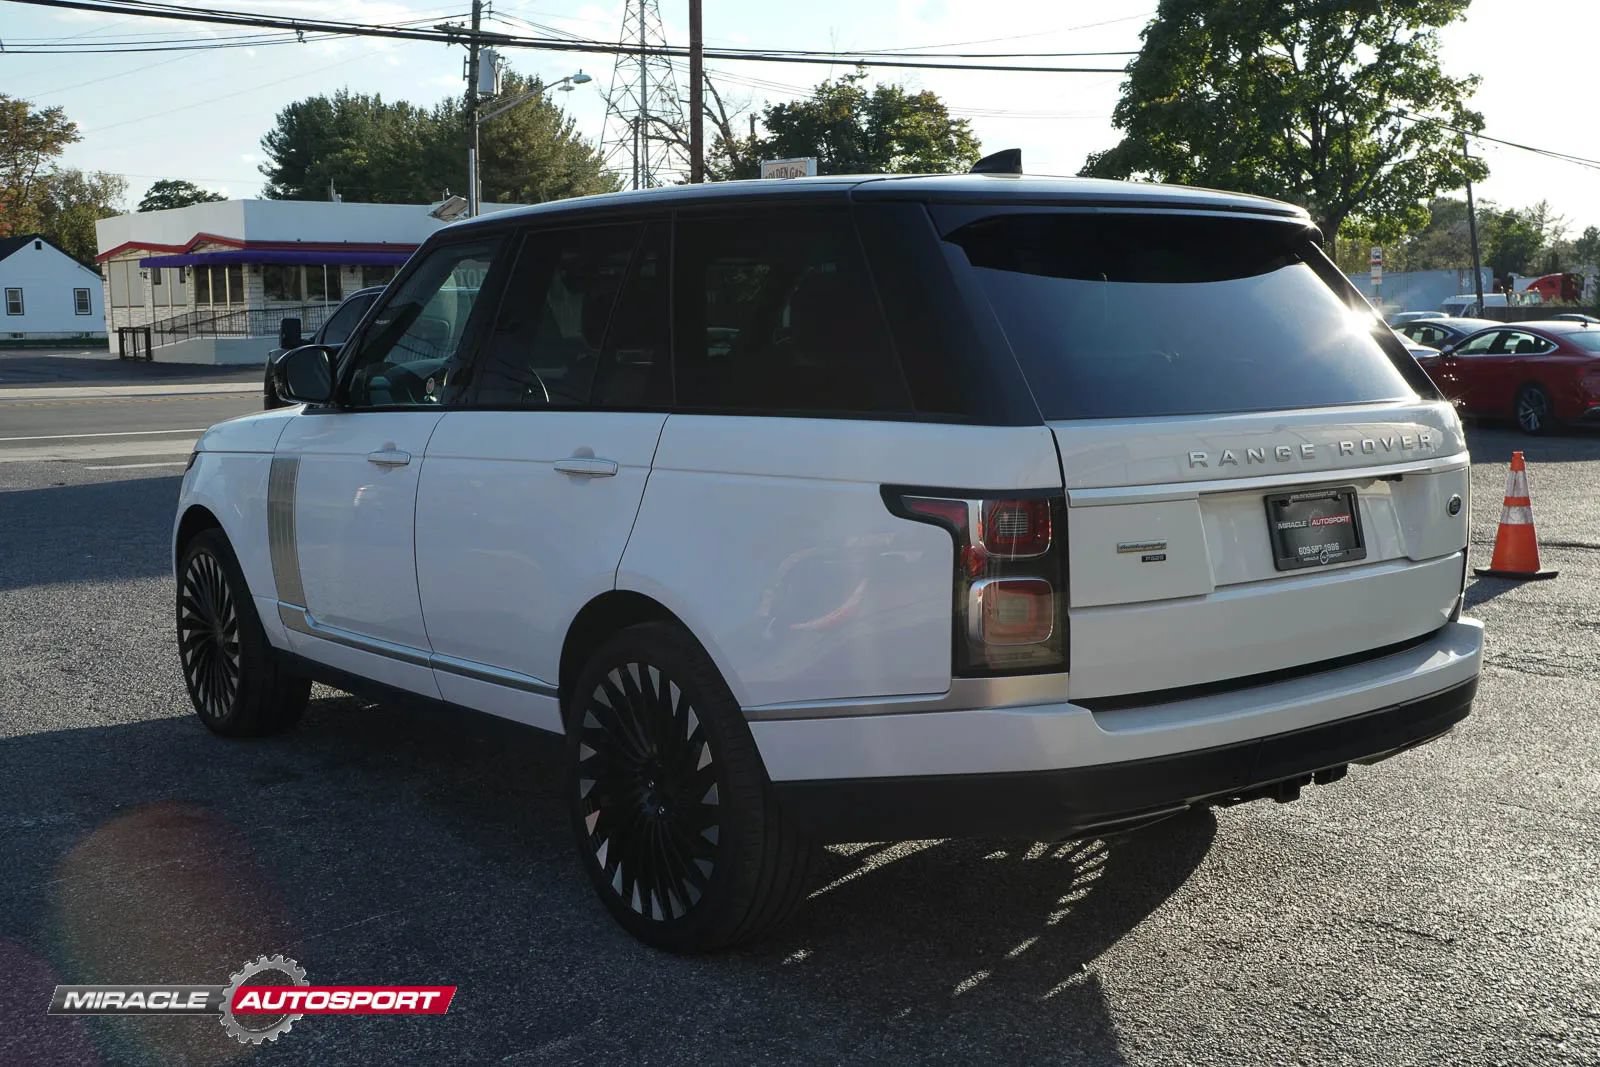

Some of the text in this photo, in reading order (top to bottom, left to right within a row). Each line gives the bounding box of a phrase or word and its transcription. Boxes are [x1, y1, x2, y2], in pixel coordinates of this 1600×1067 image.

[1188, 434, 1433, 468] RANGE ROVER
[1278, 515, 1350, 530] MIRACLE AUTOSPORT
